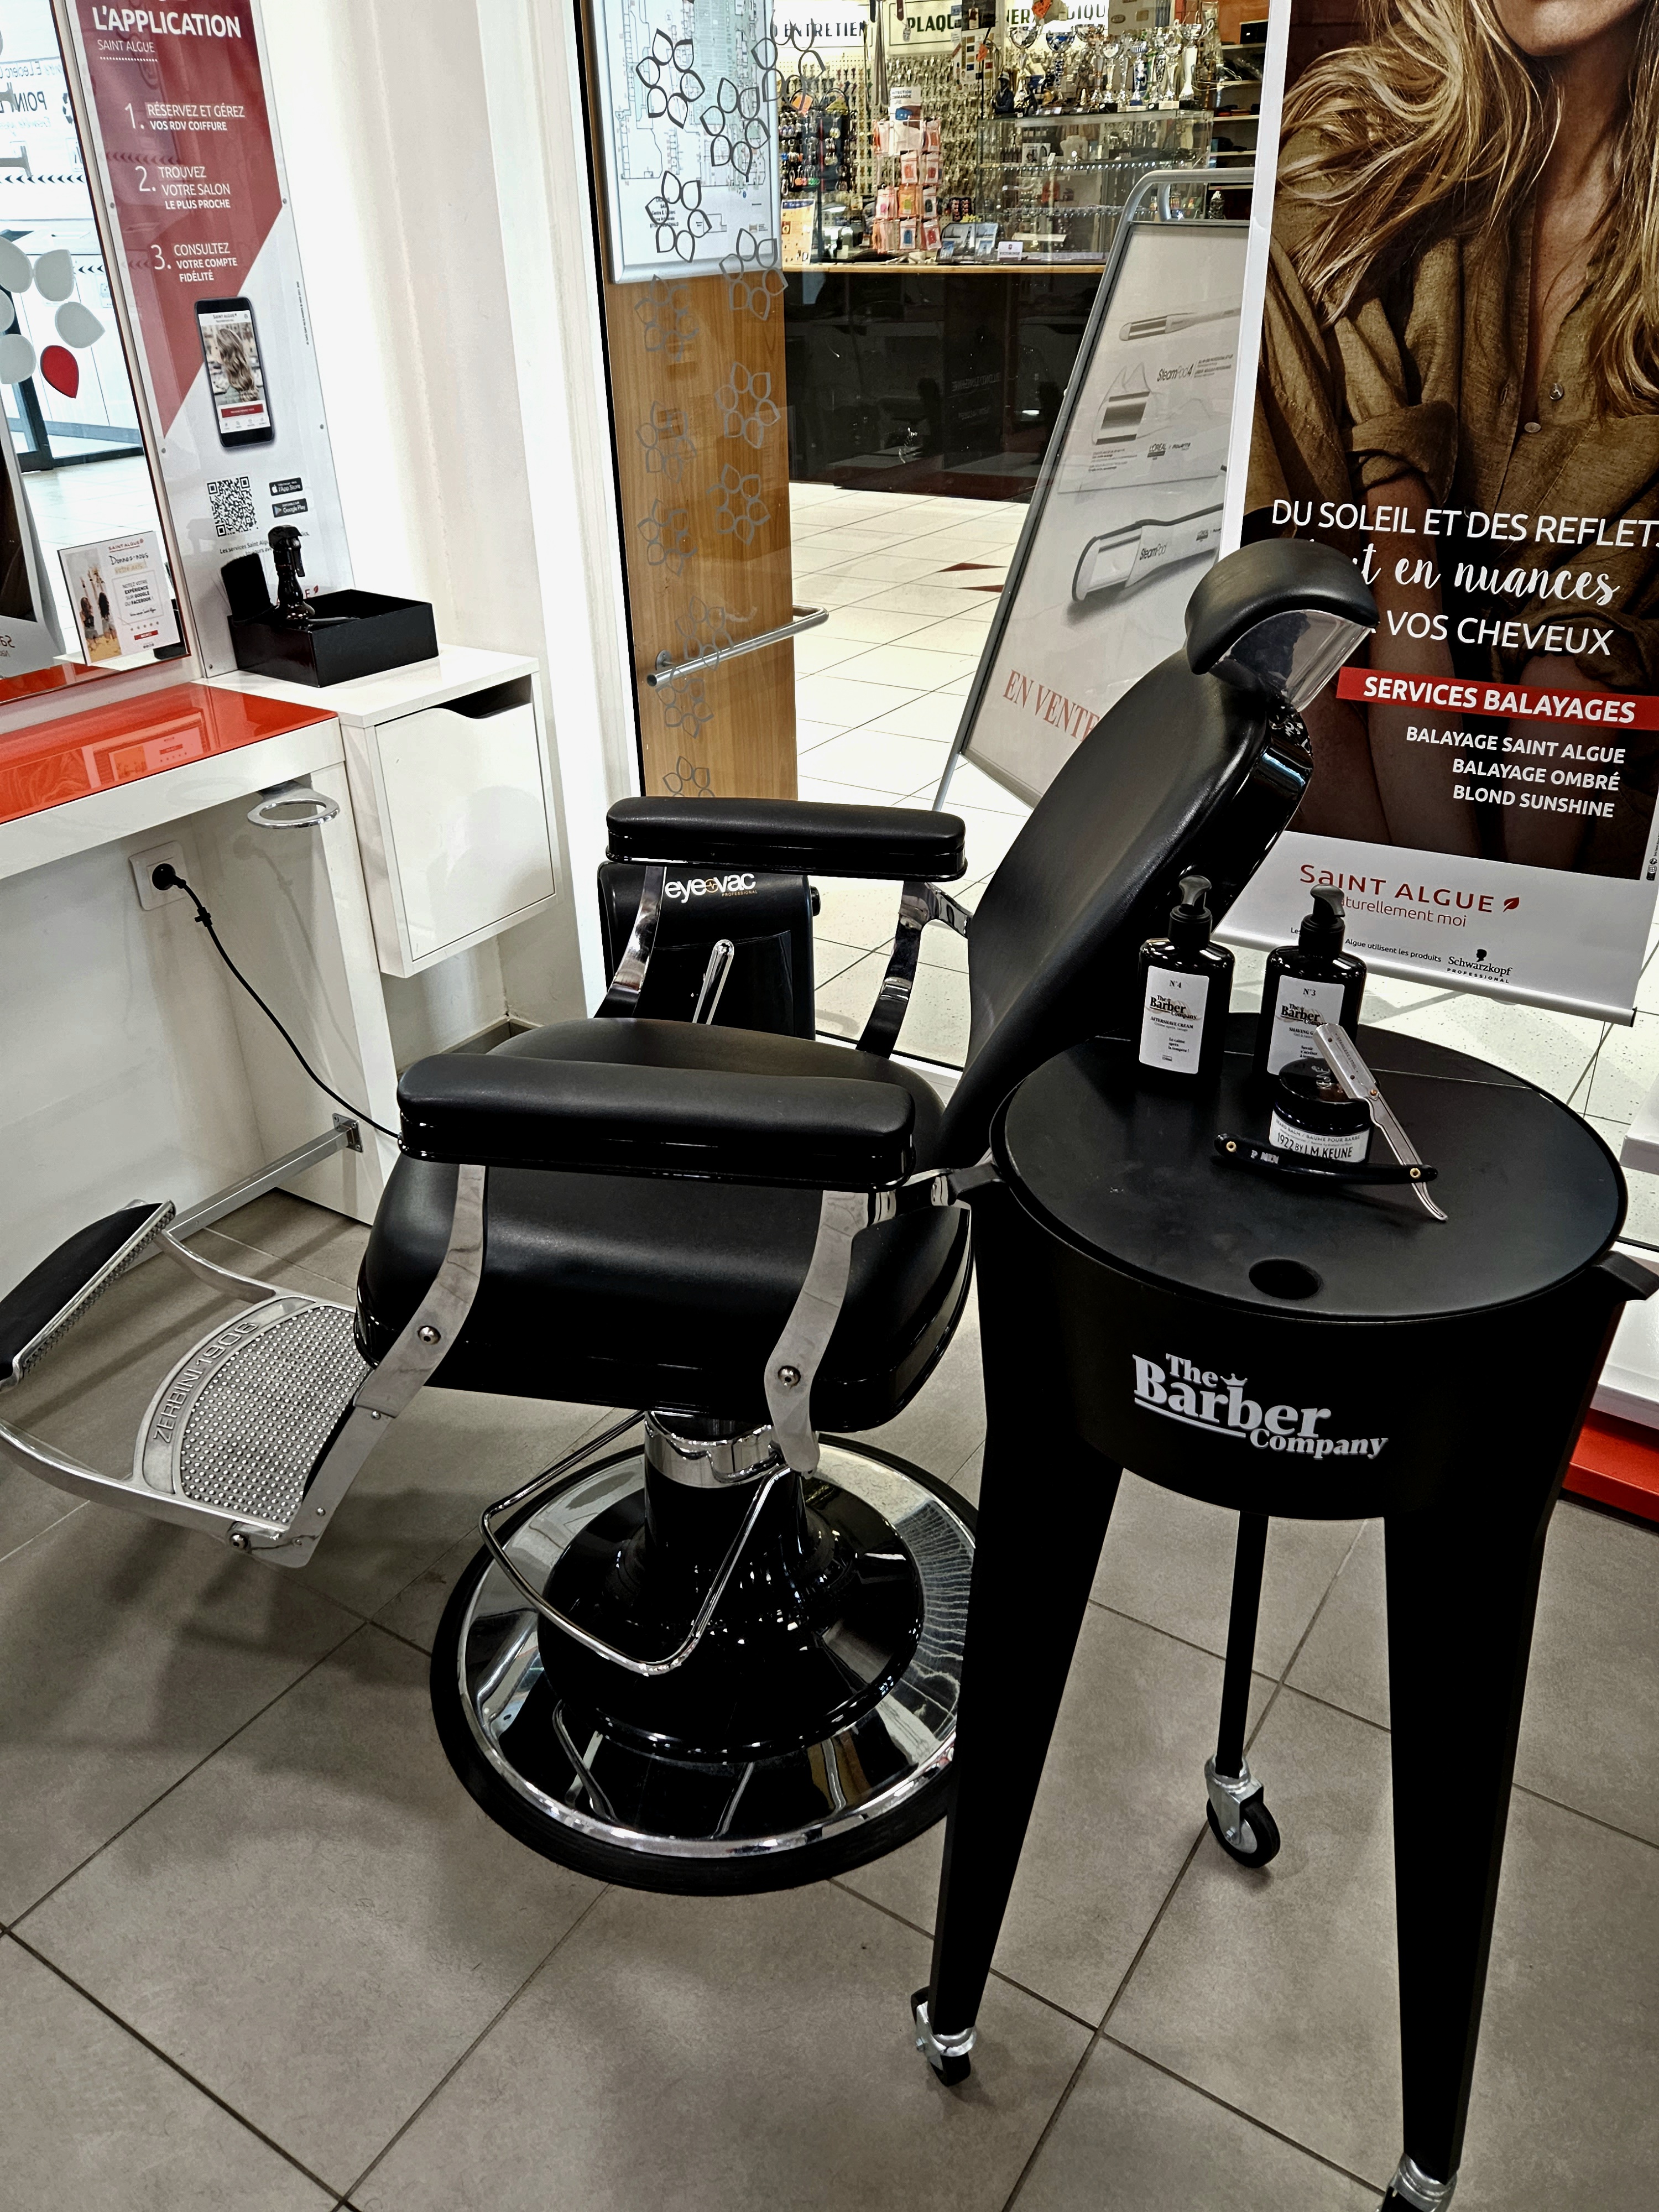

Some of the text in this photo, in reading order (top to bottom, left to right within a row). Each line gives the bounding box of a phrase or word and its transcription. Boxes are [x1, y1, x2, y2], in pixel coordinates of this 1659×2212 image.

[92, 6, 241, 38] L'APPLICATION
[907, 14, 956, 33] PLAQU
[97, 39, 155, 53] SAINT ALGUE
[125, 103, 144, 129] 1.
[148, 102, 245, 118] RÉSERVEZ ET GÉREZ
[150, 121, 227, 131] VOS RDV COIFFURE
[135, 166, 156, 191] 2.
[158, 166, 207, 178] TROUVEZ
[161, 184, 231, 196] VOTRE SALON
[165, 199, 231, 210] LE PLUS PROCHE
[150, 244, 171, 270] 3.
[174, 242, 230, 256] CONSULTEZ
[176, 258, 238, 269] VOTRE COMPTE
[179, 269, 214, 283] FIDÉLITÉ
[1272, 499, 1659, 547] DU SOLEIL ET DES REFLET
[1395, 558, 1441, 589] en
[1454, 562, 1620, 606] nuances
[1387, 611, 1614, 655] VOS CHEVEUX
[1003, 669, 1035, 709] EN
[1364, 676, 1636, 723] SERVICES BALAYAGES
[1406, 726, 1626, 764] BALAYAGE SAINT ALGUE
[1452, 758, 1620, 791] BALAYAGE OMBRÉ
[1453, 785, 1615, 818] BLOND SUNSHINE
[1394, 884, 1494, 913] ALGUE
[1341, 896, 1467, 927] turellement moi
[1345, 938, 1441, 963] Algue utilisent les produits
[1447, 968, 1510, 984] PROFESSIONAL
[1448, 956, 1513, 977] Schwarzkopf
[1150, 997, 1186, 1014] Barber
[1171, 1011, 1198, 1020] Company
[1281, 1005, 1320, 1021] Barber
[1150, 1016, 1177, 1026] AFTERSHAVE
[1289, 1027, 1310, 1035] SHAVING
[1277, 1133, 1294, 1149] 1922
[1295, 1143, 1303, 1151] BY
[1322, 1146, 1353, 1159] KEUNE
[153, 1322, 259, 1443] ZERBINI 1906
[1166, 1353, 1218, 1387] The
[1132, 1354, 1332, 1438] Barber
[1250, 1428, 1389, 1460] Company
